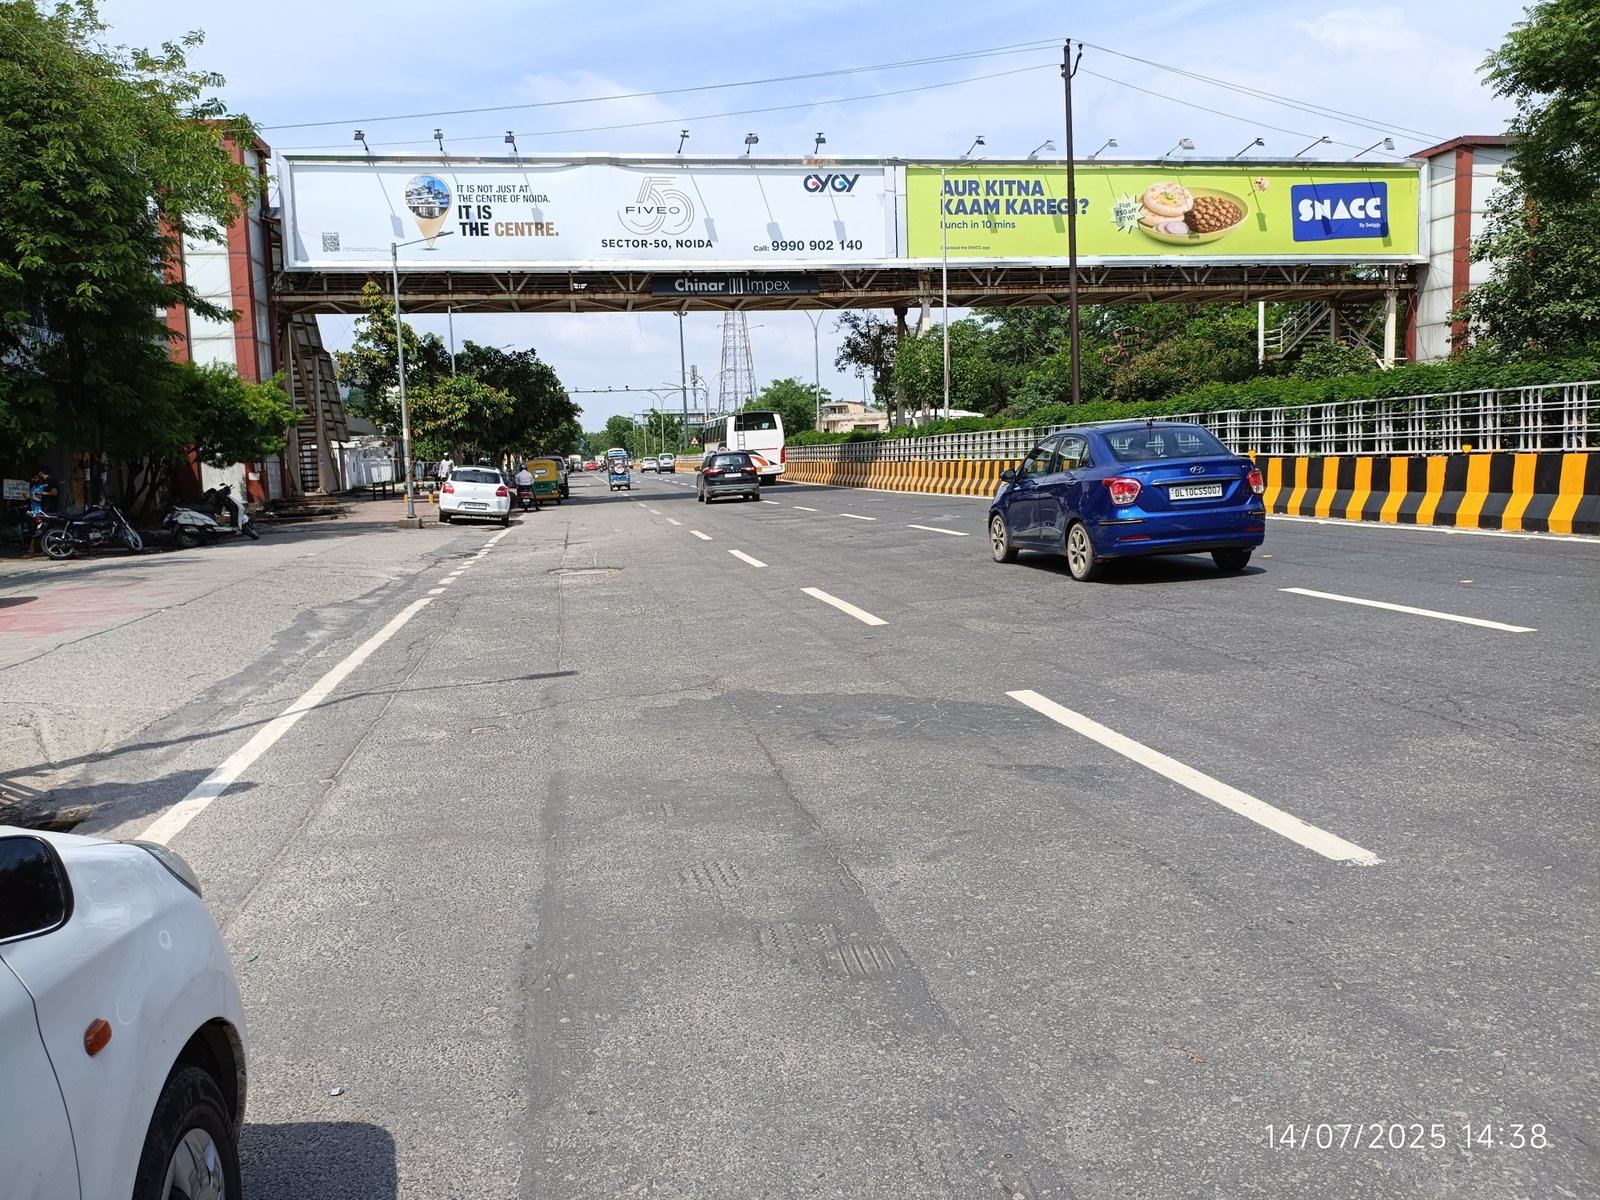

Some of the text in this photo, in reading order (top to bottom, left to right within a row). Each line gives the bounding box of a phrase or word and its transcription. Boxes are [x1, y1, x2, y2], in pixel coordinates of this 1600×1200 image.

[457, 184, 529, 193] IT IS NOT JUST AT
[940, 180, 1045, 196] AUR KITNA
[458, 194, 551, 203] THE CENTRE OF NOIDA.
[458, 205, 492, 219] IT IS
[625, 206, 681, 214] FIVEO
[940, 199, 1000, 215] KAAM
[1298, 197, 1381, 222] SNACC
[459, 222, 559, 236] THE CENTRE.
[970, 220, 979, 229] in
[981, 220, 992, 229] 10
[994, 220, 1016, 229] mins
[601, 239, 713, 249] SECTOR-50, NOIDA
[771, 240, 805, 251] 9990
[809, 240, 834, 251] 902
[839, 240, 863, 250] 140
[674, 278, 790, 294] Chinar Impex
